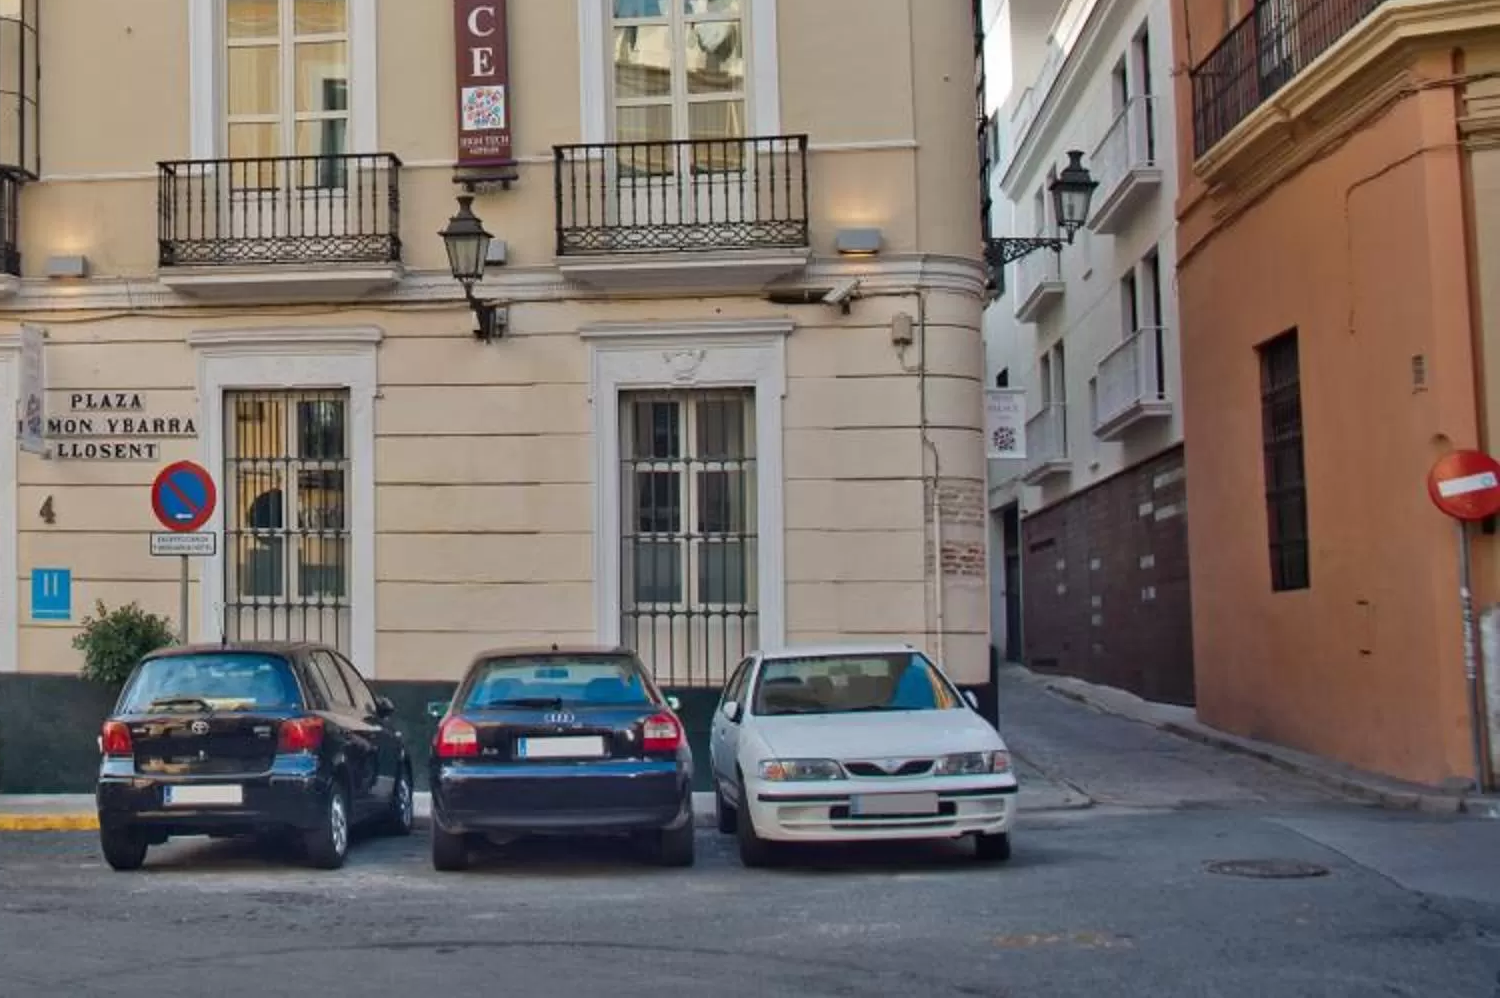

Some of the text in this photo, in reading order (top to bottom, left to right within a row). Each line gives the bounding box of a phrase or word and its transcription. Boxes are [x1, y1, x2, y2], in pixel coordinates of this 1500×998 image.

[70, 393, 143, 409] PLAZA
[107, 418, 197, 434] YBARRA
[57, 443, 157, 459] LLOSENT
[39, 494, 57, 524] 4
